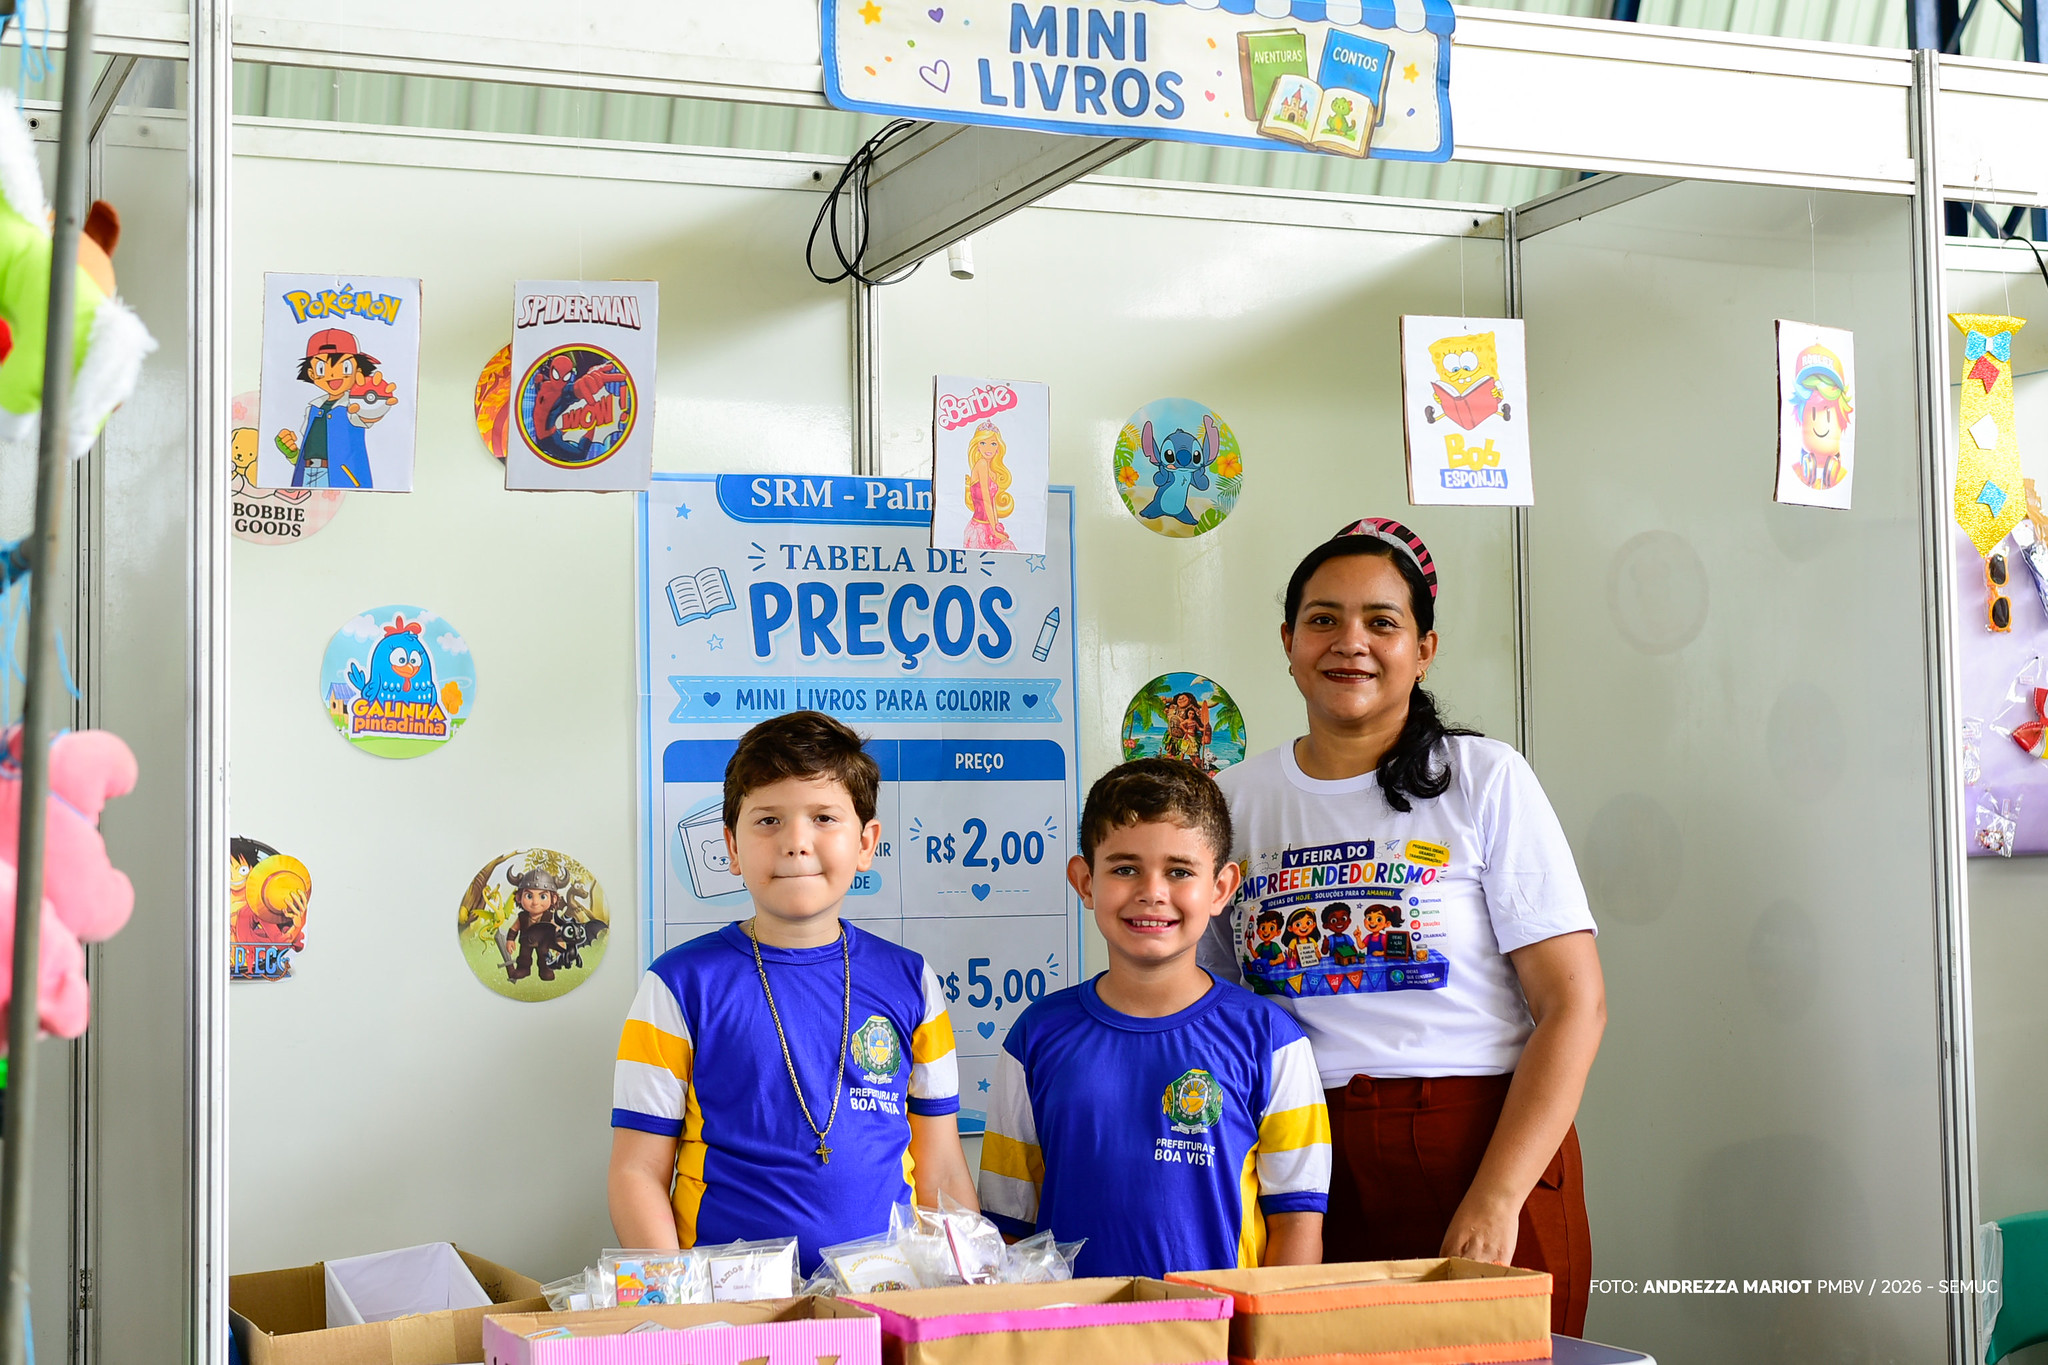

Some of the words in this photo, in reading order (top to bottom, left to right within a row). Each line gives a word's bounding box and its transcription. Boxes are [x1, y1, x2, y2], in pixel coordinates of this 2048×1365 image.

[1009, 2, 1147, 62] MINI
[1254, 49, 1303, 65] AVENTURAS
[1332, 46, 1379, 72] CONTOS
[977, 58, 1185, 120] LIVROS
[517, 295, 642, 330] SPIDER-MAN
[939, 384, 1017, 430] Barbie
[1443, 433, 1501, 472] Bob
[1444, 469, 1506, 489] ESPONJA
[751, 478, 834, 509] SRM
[232, 502, 305, 522] BOBBIE
[234, 518, 302, 538] GOODS
[780, 544, 916, 573] TABELA
[926, 547, 968, 574] DE
[748, 580, 1014, 671] PREÇOS
[353, 697, 447, 722] GALINHA
[735, 688, 786, 711] MINI
[795, 688, 867, 712] LIVROS
[876, 688, 928, 712] PARA
[935, 689, 1011, 713] COLORIR
[353, 714, 446, 736] pintadinha
[954, 752, 1005, 775] PREÇO
[926, 832, 956, 865] R$
[962, 817, 1045, 873] 2,00
[1289, 853, 1299, 866] V
[1302, 848, 1343, 864] FEIRA
[1346, 845, 1368, 859] DO
[1267, 898, 1286, 908] IDEIAS
[1286, 895, 1295, 903] DE
[1314, 890, 1344, 900] SOLUÇÕES
[1345, 889, 1360, 897] PARA
[967, 957, 1047, 1012] 5,00
[850, 1098, 877, 1112] BOA
[1154, 1148, 1182, 1163] BOA
[1156, 1137, 1209, 1152] PREFEITURA
